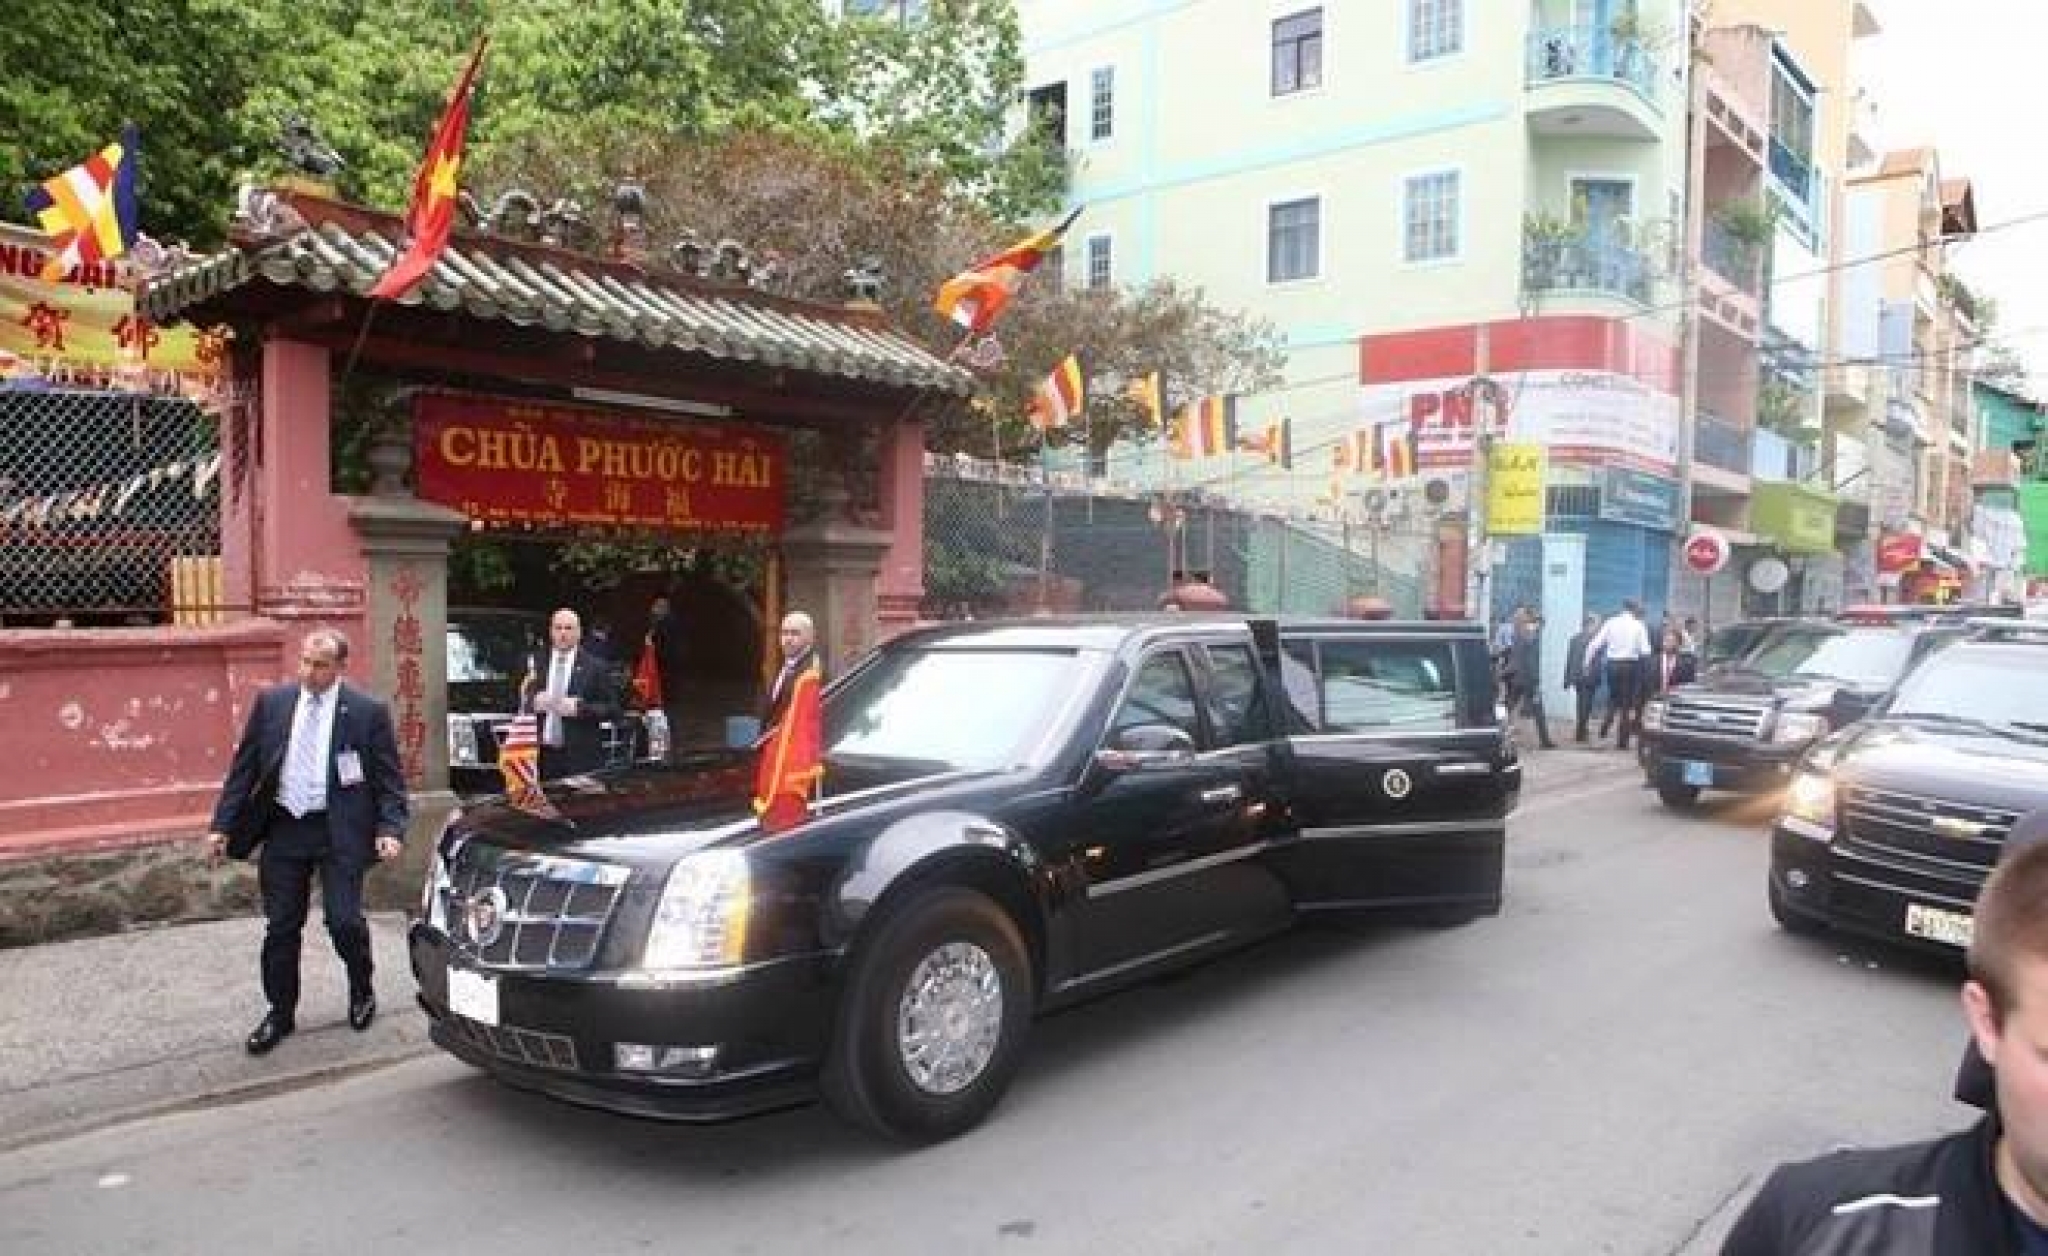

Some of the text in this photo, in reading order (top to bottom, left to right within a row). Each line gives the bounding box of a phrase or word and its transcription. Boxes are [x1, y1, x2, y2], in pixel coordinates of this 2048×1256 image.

[440, 420, 565, 472] CHÙA
[576, 433, 701, 482] PHƯỚC
[712, 438, 771, 488] HẢI
